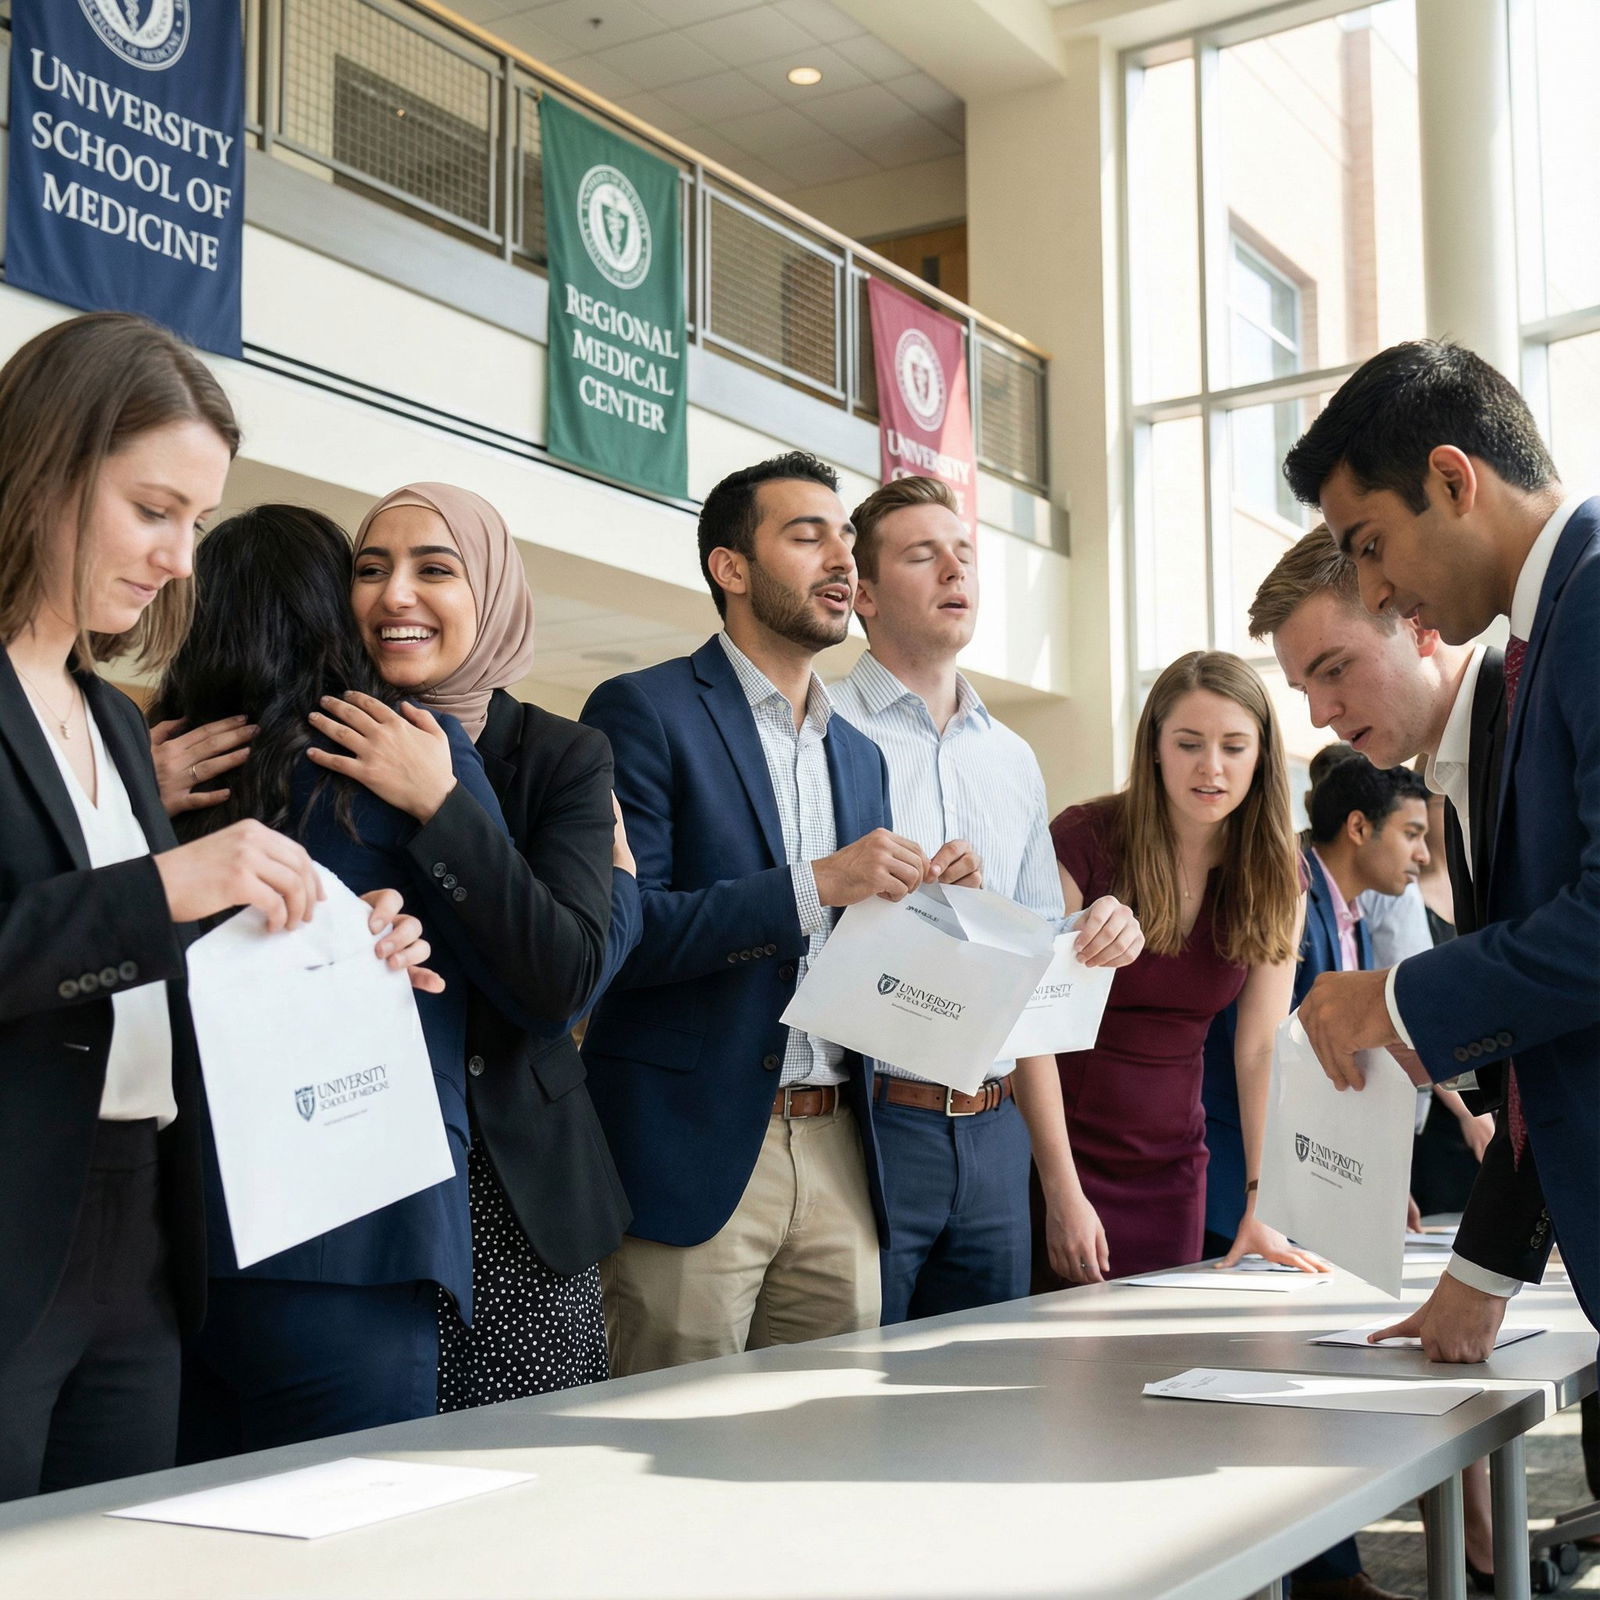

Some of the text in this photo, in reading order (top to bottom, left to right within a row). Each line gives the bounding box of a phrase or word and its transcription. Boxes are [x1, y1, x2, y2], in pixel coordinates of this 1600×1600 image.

[31, 48, 234, 168] UNIVERSITY
[31, 111, 232, 219] SCHOOL OF
[43, 172, 220, 272] MEDICINE
[565, 283, 680, 360] REGIONAL
[572, 329, 675, 397] MEDICAL
[578, 375, 667, 434] CENTER
[887, 428, 971, 486] UNIVERSITY
[317, 1063, 387, 1100] UNIVERSITY
